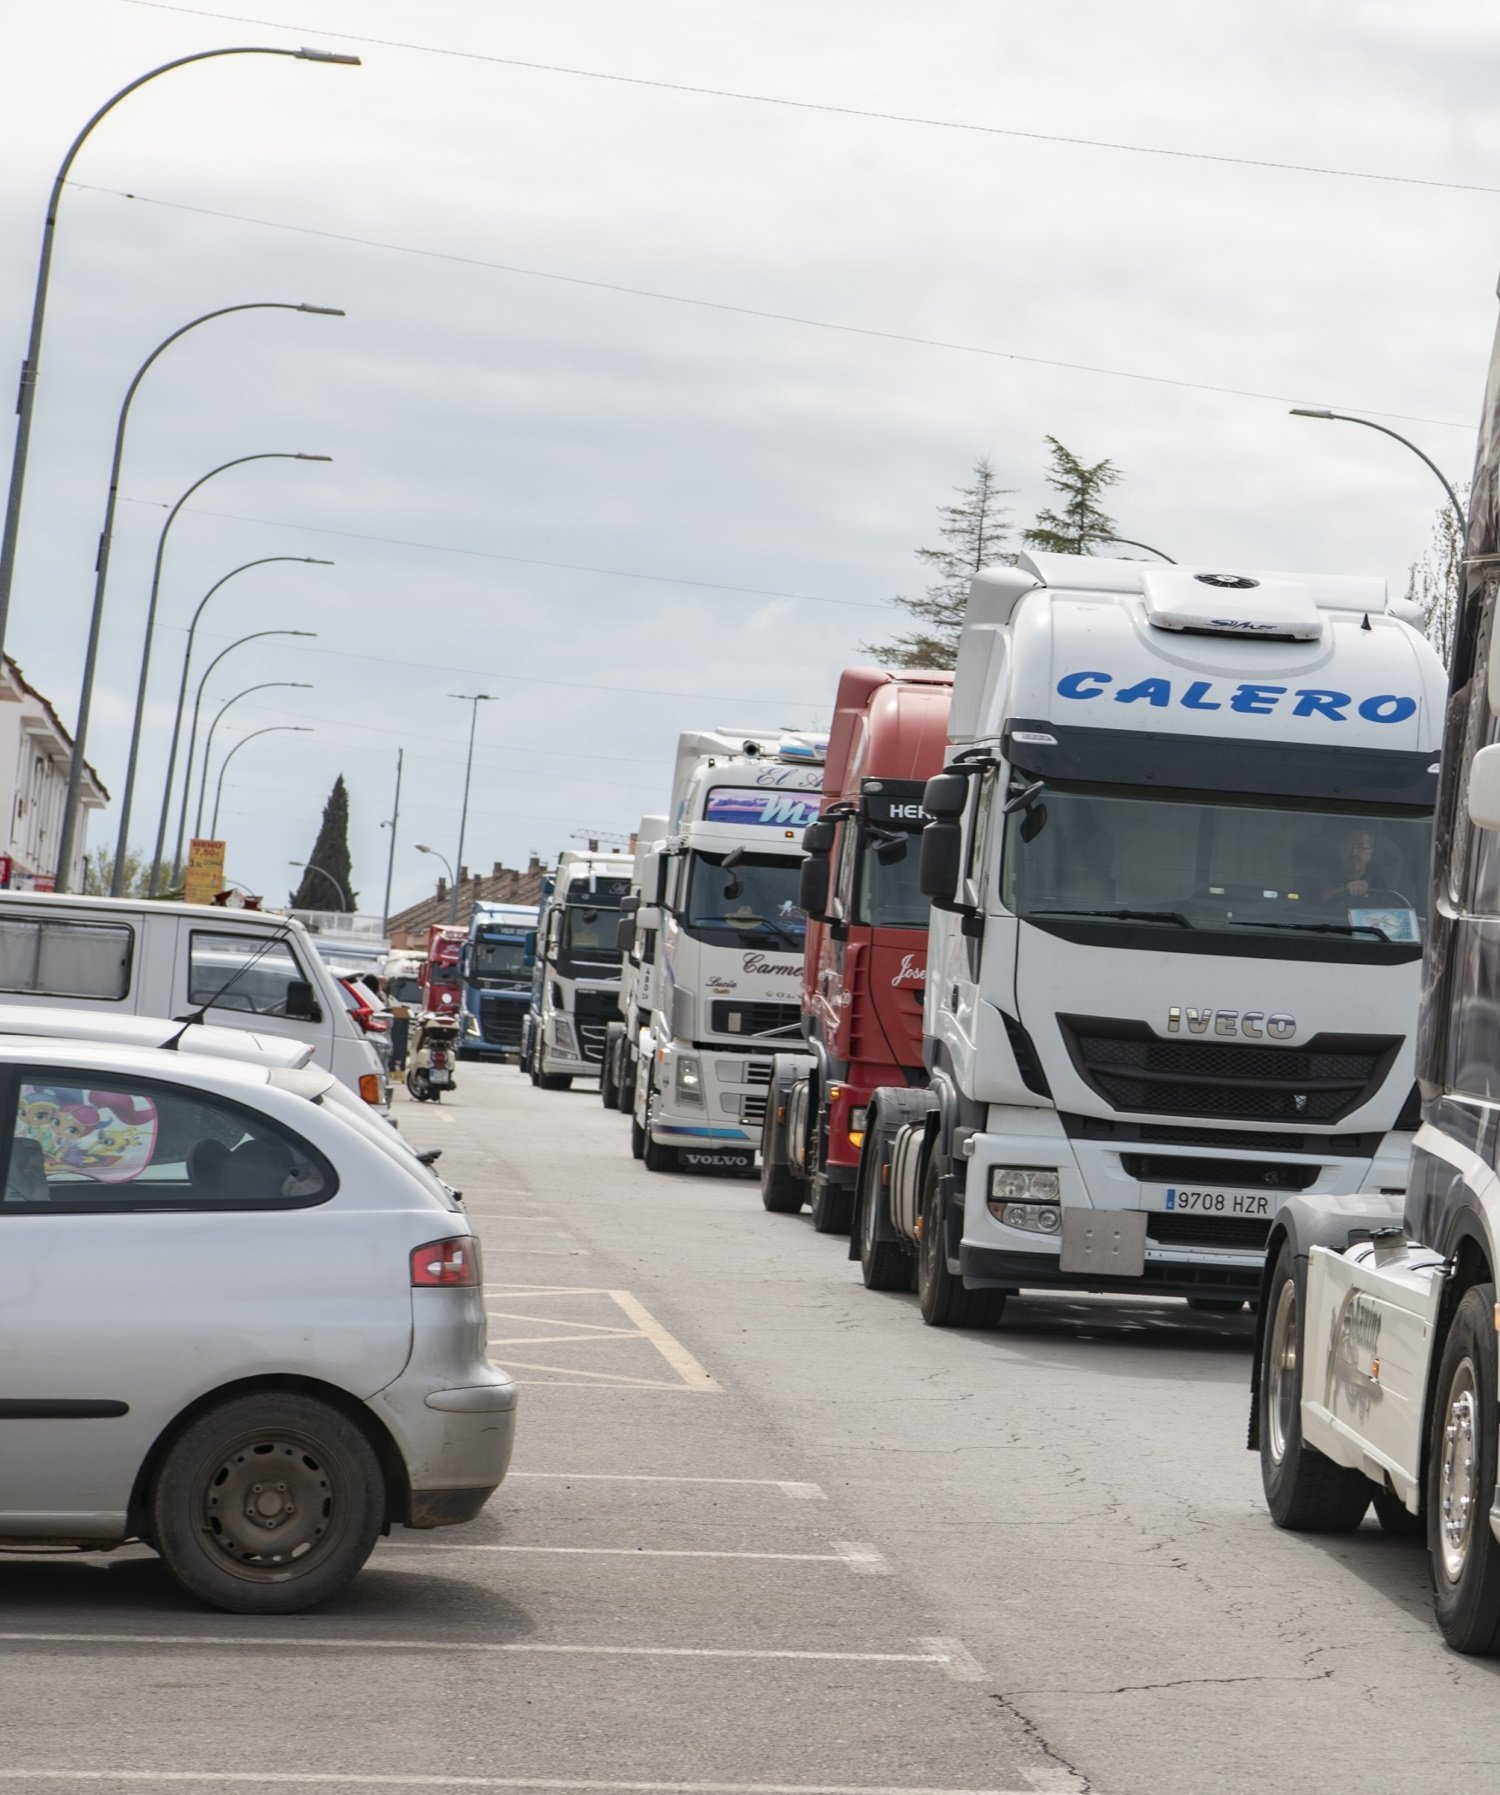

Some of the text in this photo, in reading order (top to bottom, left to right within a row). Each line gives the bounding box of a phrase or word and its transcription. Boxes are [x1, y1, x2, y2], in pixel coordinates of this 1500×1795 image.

[1057, 671, 1417, 724] CALERO
[1167, 1006, 1297, 1040] IVECO
[686, 1154, 748, 1166] VOLVO
[1178, 1192, 1225, 1211] 9708
[1233, 1195, 1268, 1215] HZR
